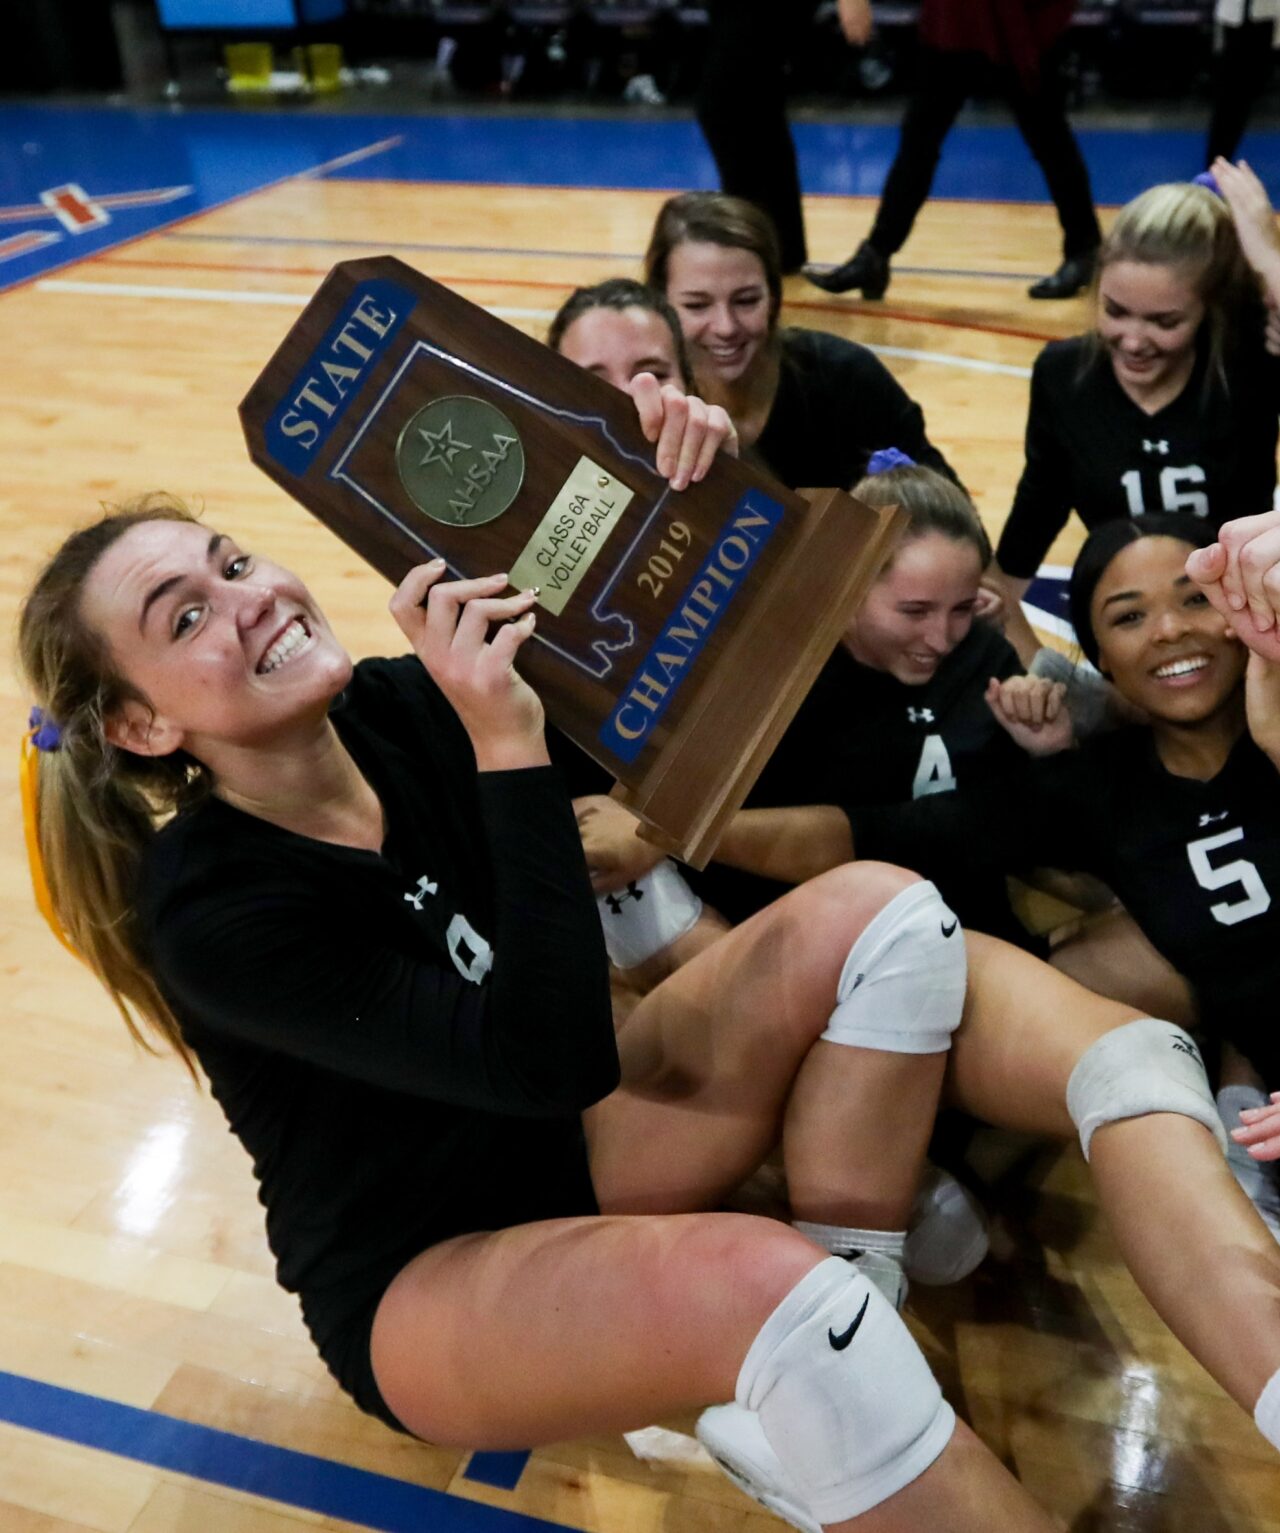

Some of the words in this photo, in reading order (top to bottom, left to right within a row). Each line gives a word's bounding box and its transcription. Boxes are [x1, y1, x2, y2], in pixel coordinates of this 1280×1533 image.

[280, 295, 397, 450] STATE
[448, 432, 518, 523] AHSAA
[535, 514, 576, 568] CLASS
[573, 493, 591, 516] 6A
[546, 498, 616, 592] VOLLEYBALL
[637, 520, 692, 599] 2019
[614, 504, 771, 740] CHAMPION
[912, 734, 957, 800] 4
[1187, 826, 1271, 926] 5
